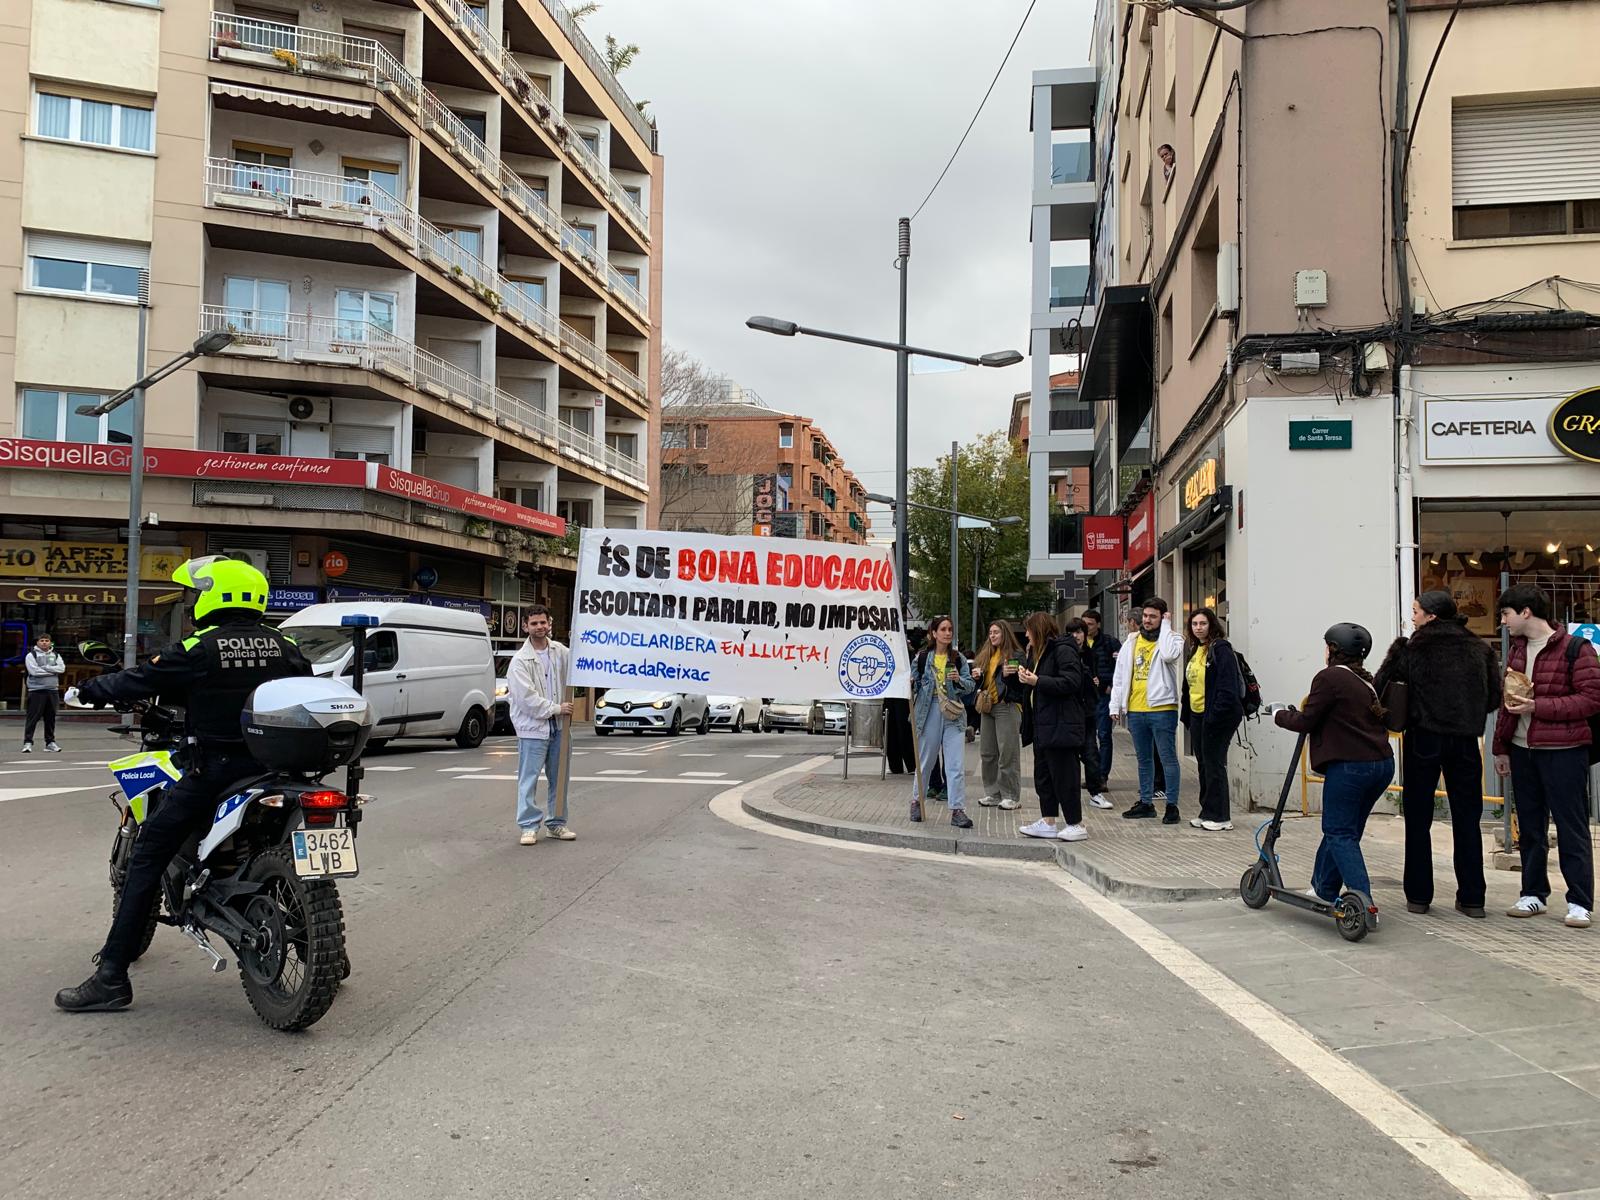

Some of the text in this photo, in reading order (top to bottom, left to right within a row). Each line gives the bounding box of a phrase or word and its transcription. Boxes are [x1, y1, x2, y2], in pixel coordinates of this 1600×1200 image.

[1431, 420, 1536, 436] CAFETERIA
[0, 439, 158, 472] SisquellaGrp
[196, 456, 268, 476] gestionem
[389, 470, 450, 503] SisquellaGrup
[42, 546, 114, 561] TAPES
[325, 555, 344, 568] ria
[598, 537, 893, 593] ÉS DE BONA EDUCACIÓ
[17, 587, 128, 604] Gauch
[579, 590, 677, 619] ESCOLTAR
[692, 595, 780, 629] PARLAR,
[785, 602, 815, 627] NO
[819, 603, 900, 632] IMPOSAR
[216, 637, 280, 650] POLICIA
[580, 629, 717, 654] #SOMDELARIBERA
[720, 640, 745, 659] EN
[220, 649, 282, 661] policia local
[576, 657, 711, 683] #MontcadaReixac
[844, 679, 855, 692] INS
[856, 687, 865, 695] LA
[121, 771, 156, 780] Policia Local
[307, 832, 351, 851] 3462
[297, 848, 304, 856] E
[309, 851, 342, 872] LWB
